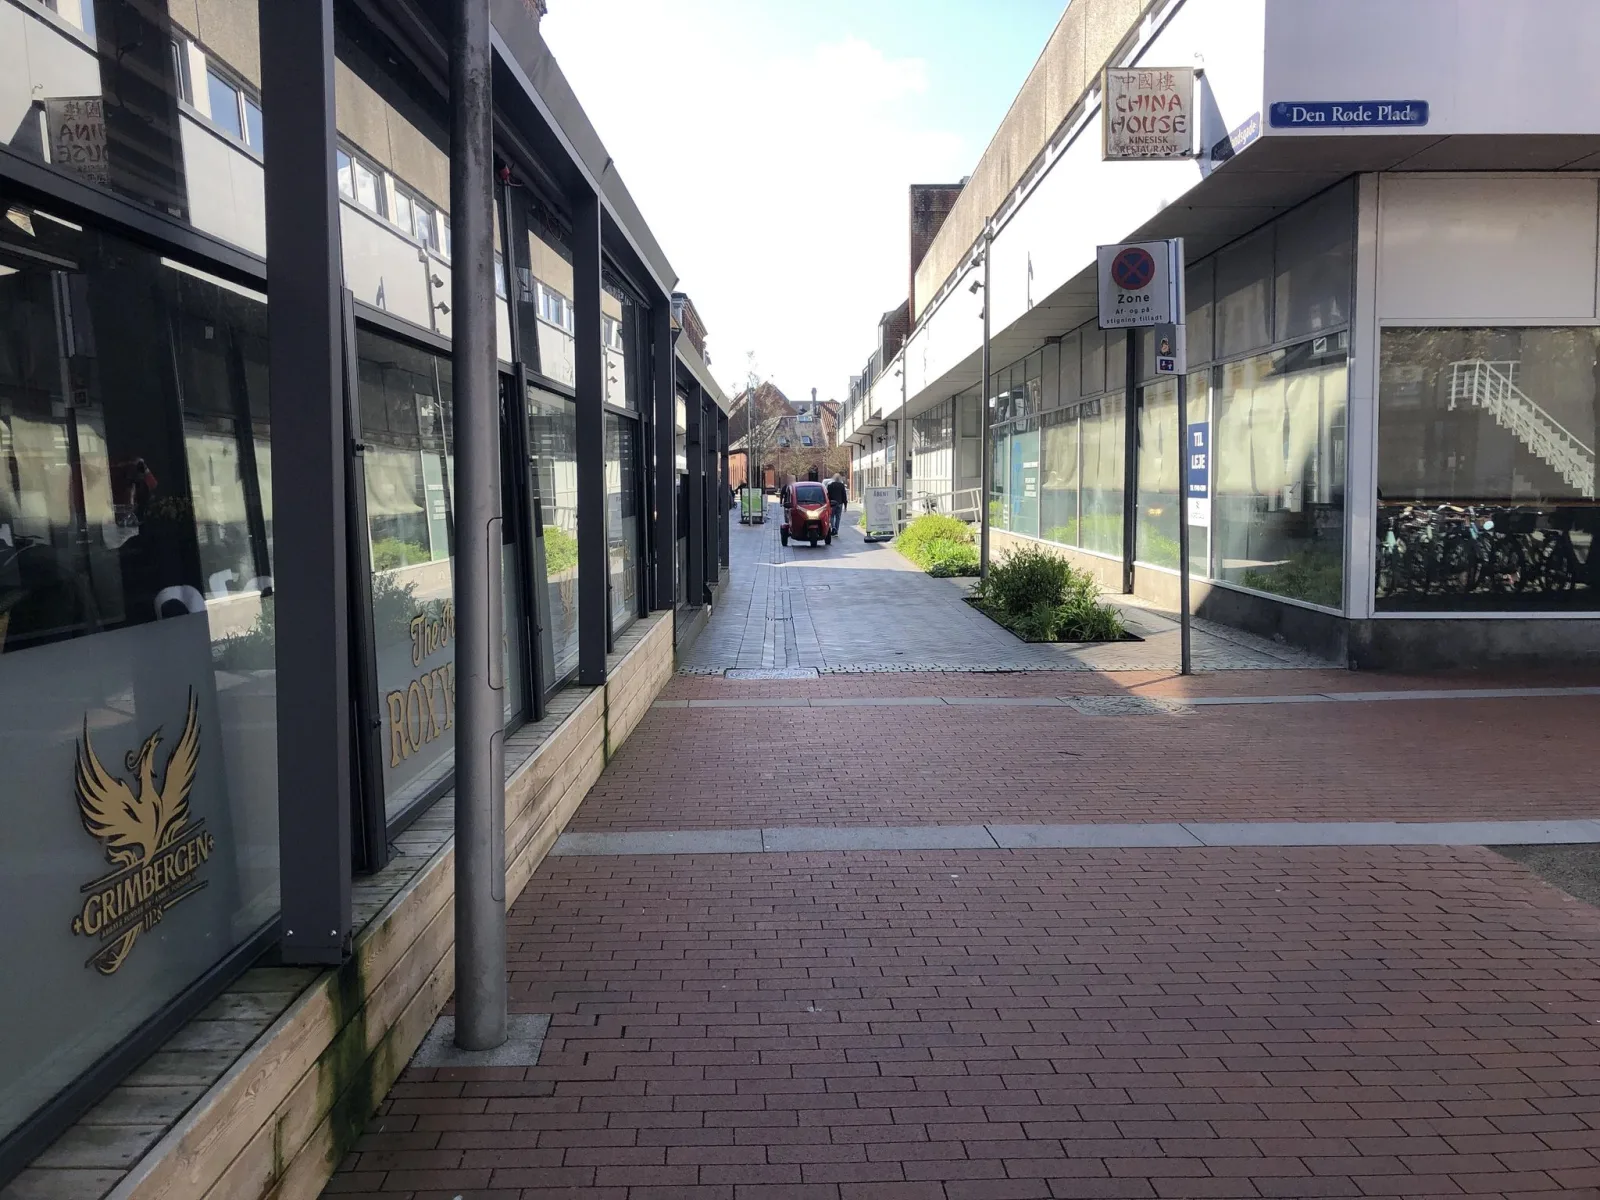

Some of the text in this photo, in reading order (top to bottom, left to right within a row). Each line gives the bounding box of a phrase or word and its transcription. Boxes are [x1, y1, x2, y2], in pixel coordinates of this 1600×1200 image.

[1115, 93, 1182, 113] CHINA
[1292, 106, 1325, 122] Den
[1332, 105, 1372, 122] Røde
[1110, 114, 1187, 134] HOUSE
[1128, 136, 1169, 145] KINESISK
[1117, 294, 1150, 304] Zone
[1106, 314, 1163, 325] stigning tilladt
[1193, 431, 1204, 447] TIL
[410, 612, 439, 668] The
[386, 660, 455, 768] ROXY
[82, 830, 210, 936] GRIMBERGEN
